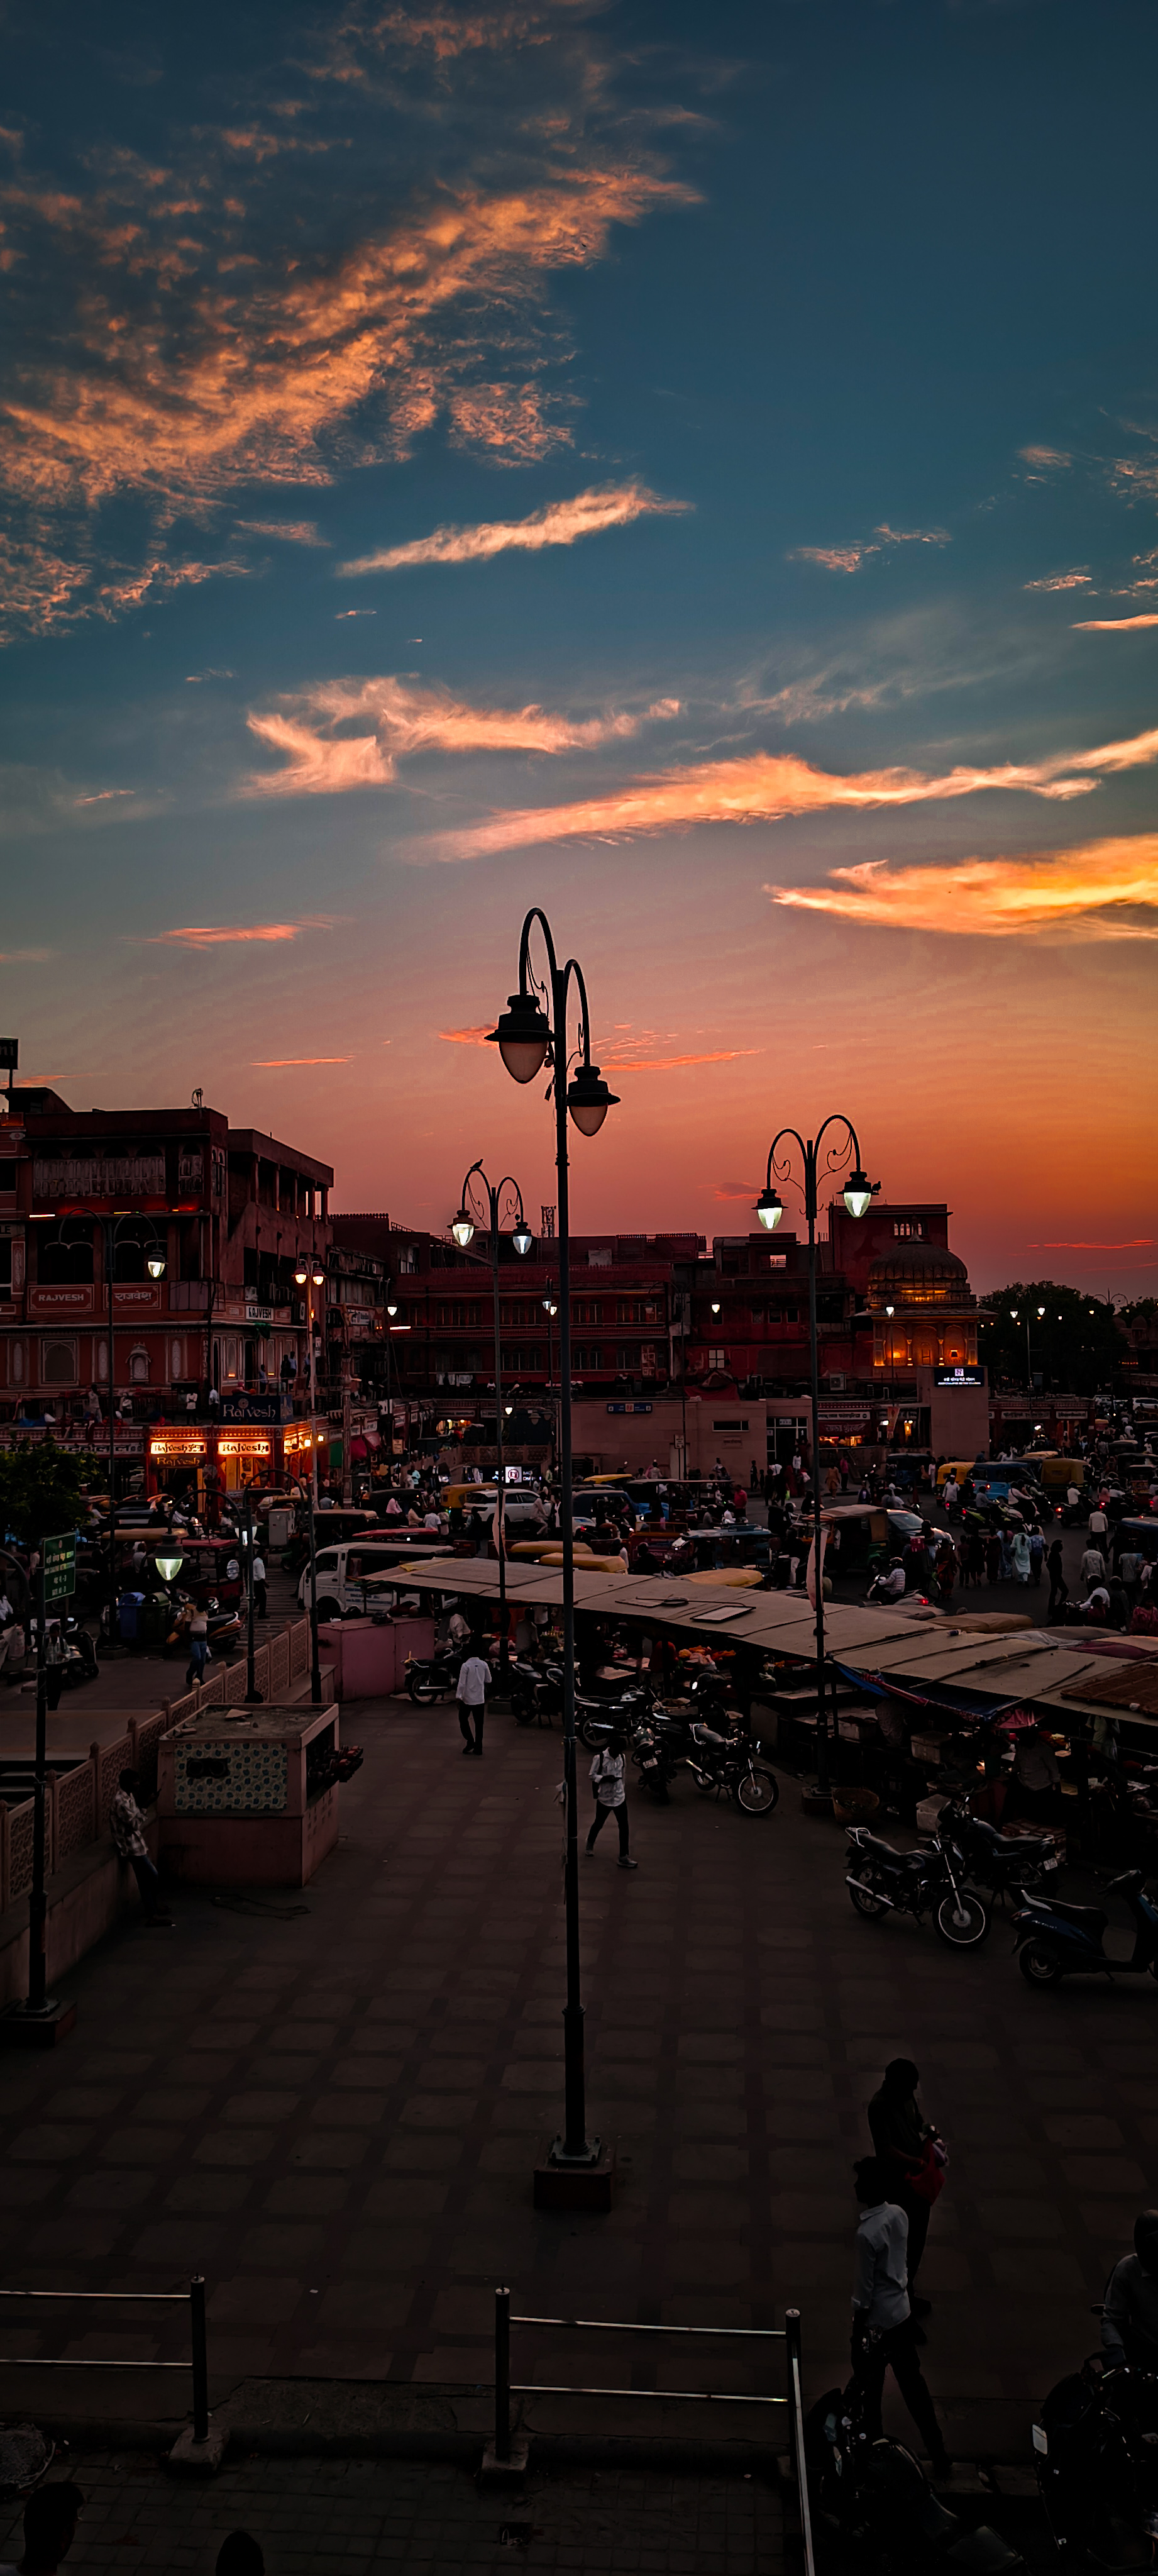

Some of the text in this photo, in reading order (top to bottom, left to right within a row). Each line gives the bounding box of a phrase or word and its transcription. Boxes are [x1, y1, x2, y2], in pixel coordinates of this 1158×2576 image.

[223, 1404, 276, 1421] Rajvesh
[222, 1443, 266, 1453] Rajvesh
[157, 1457, 200, 1467] Rajvesh
